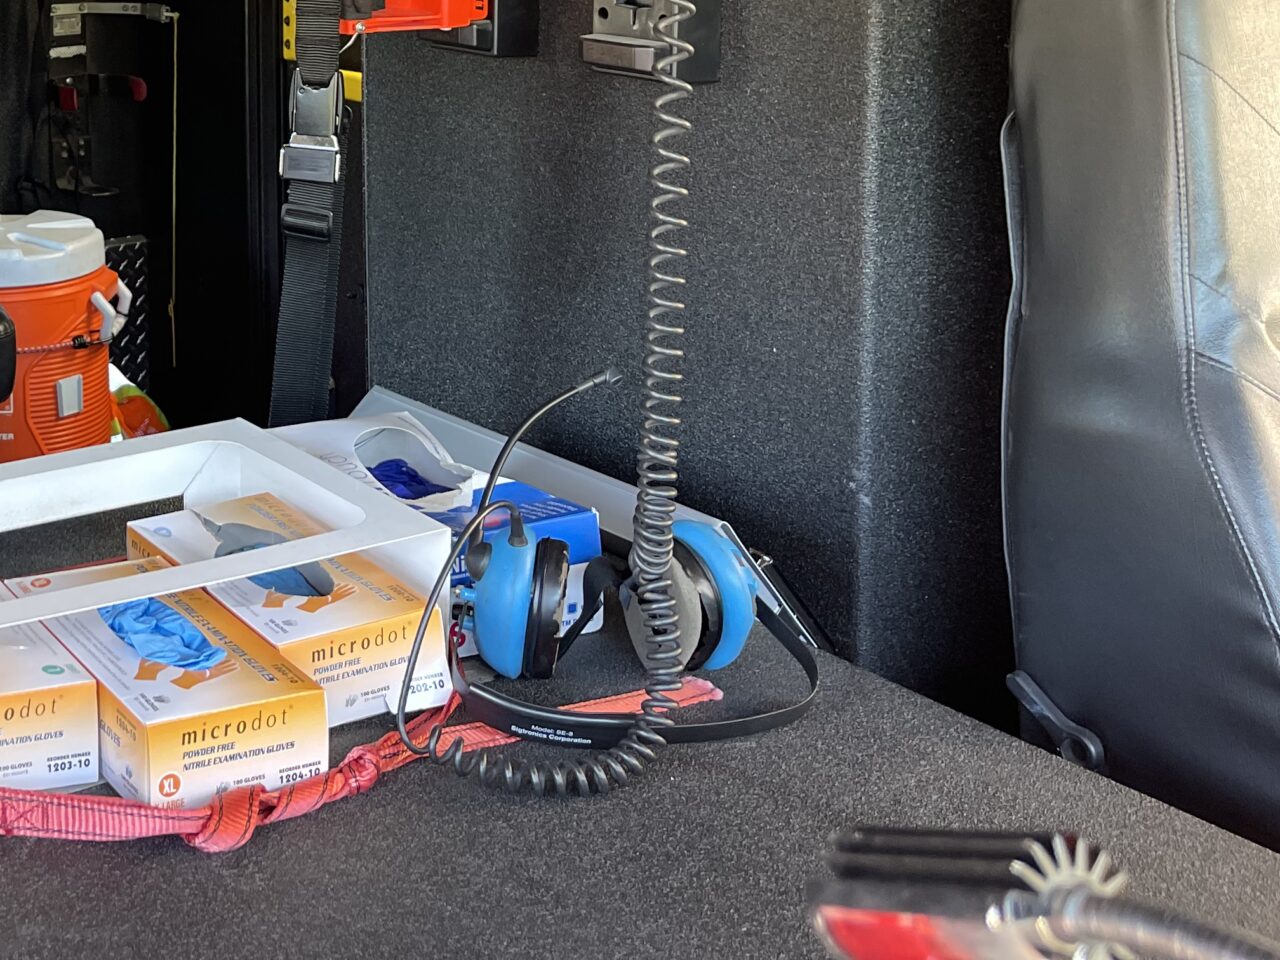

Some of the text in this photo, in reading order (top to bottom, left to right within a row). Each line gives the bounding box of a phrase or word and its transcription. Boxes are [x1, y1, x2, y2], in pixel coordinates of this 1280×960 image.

[311, 625, 407, 662] microdot
[313, 656, 362, 675] POWDER FREE
[342, 662, 389, 679] EXAMINATION
[389, 655, 411, 666] GLOV
[410, 679, 445, 695] 202-10
[34, 730, 64, 742] GLOVES
[181, 710, 288, 745] microdot
[511, 725, 592, 744] Sigtronics Corporation
[182, 741, 236, 760] POWDER FREE
[182, 741, 295, 772] NITRILE EXAMINATION GLOVES
[10, 761, 32, 769] GLOVES
[47, 758, 91, 773] 1203-10
[243, 774, 265, 783] GLOVES
[279, 768, 321, 784] 1204-10
[162, 777, 177, 795] XL
